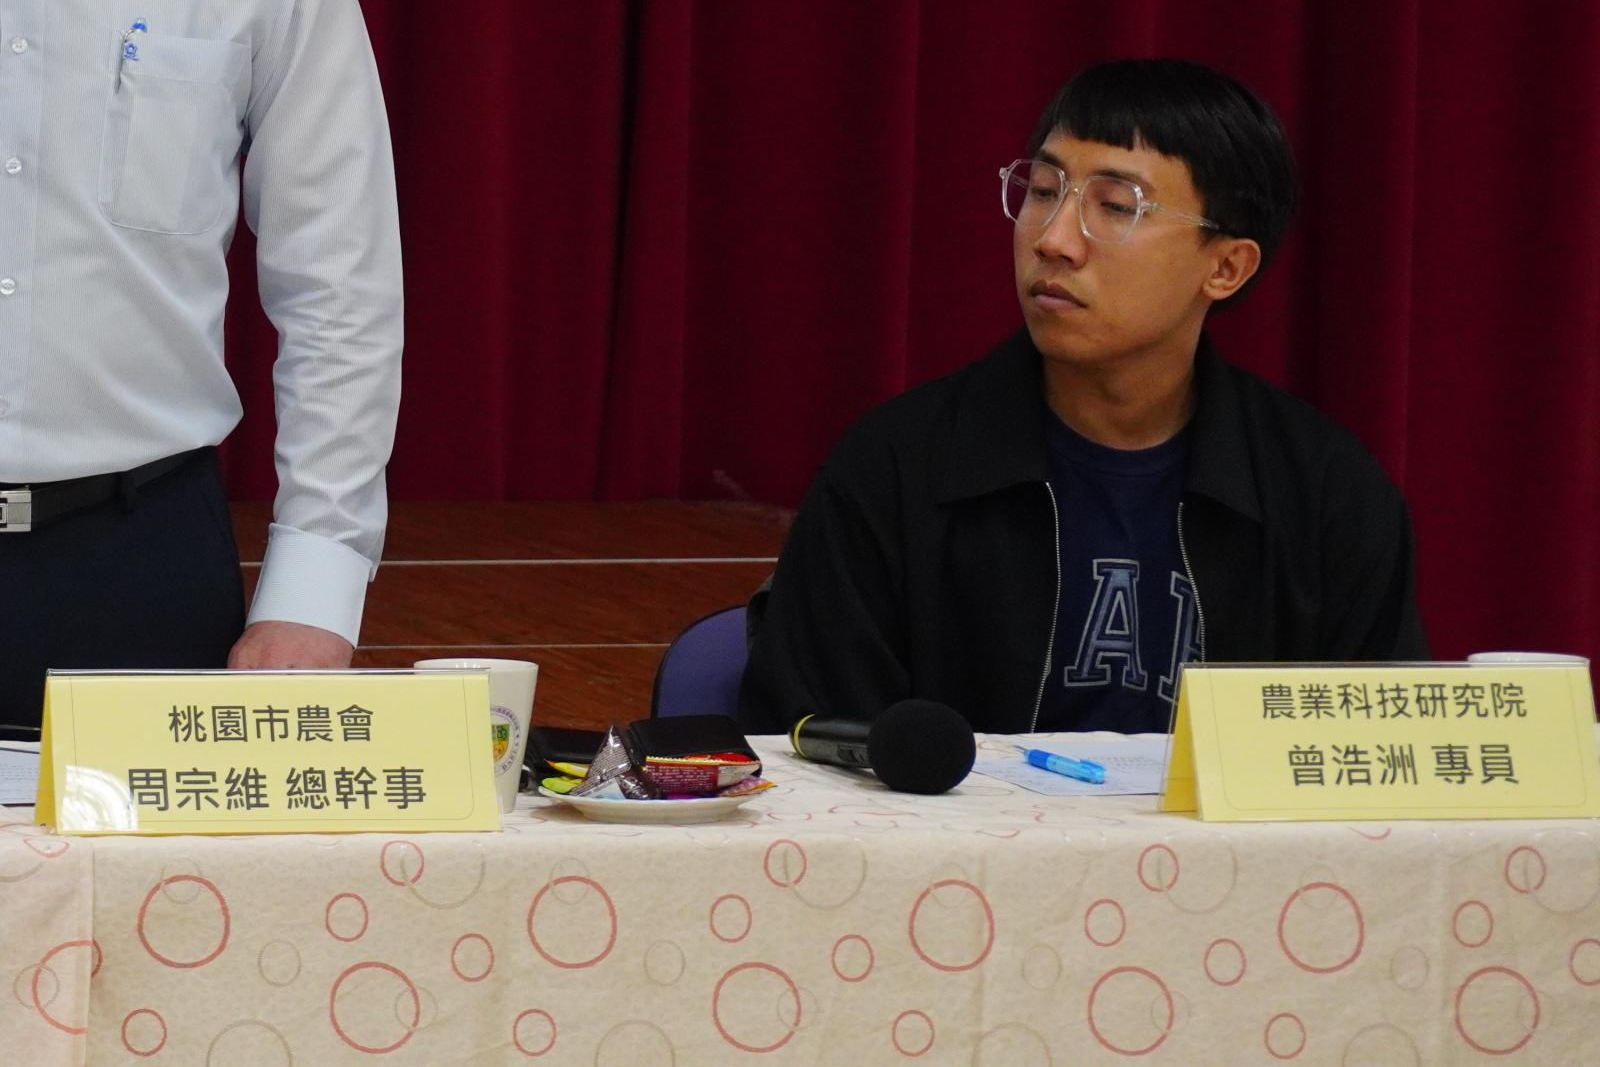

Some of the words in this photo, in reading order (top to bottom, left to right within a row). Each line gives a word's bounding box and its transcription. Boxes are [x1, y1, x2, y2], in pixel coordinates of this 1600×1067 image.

[1262, 682, 1527, 719] 農業科技研究院
[168, 704, 374, 743] 桃園市農會
[1288, 744, 1418, 786] 曾浩洲
[1431, 743, 1519, 785] 專員
[128, 767, 270, 812] 周宗維
[286, 766, 427, 810] 總幹事
